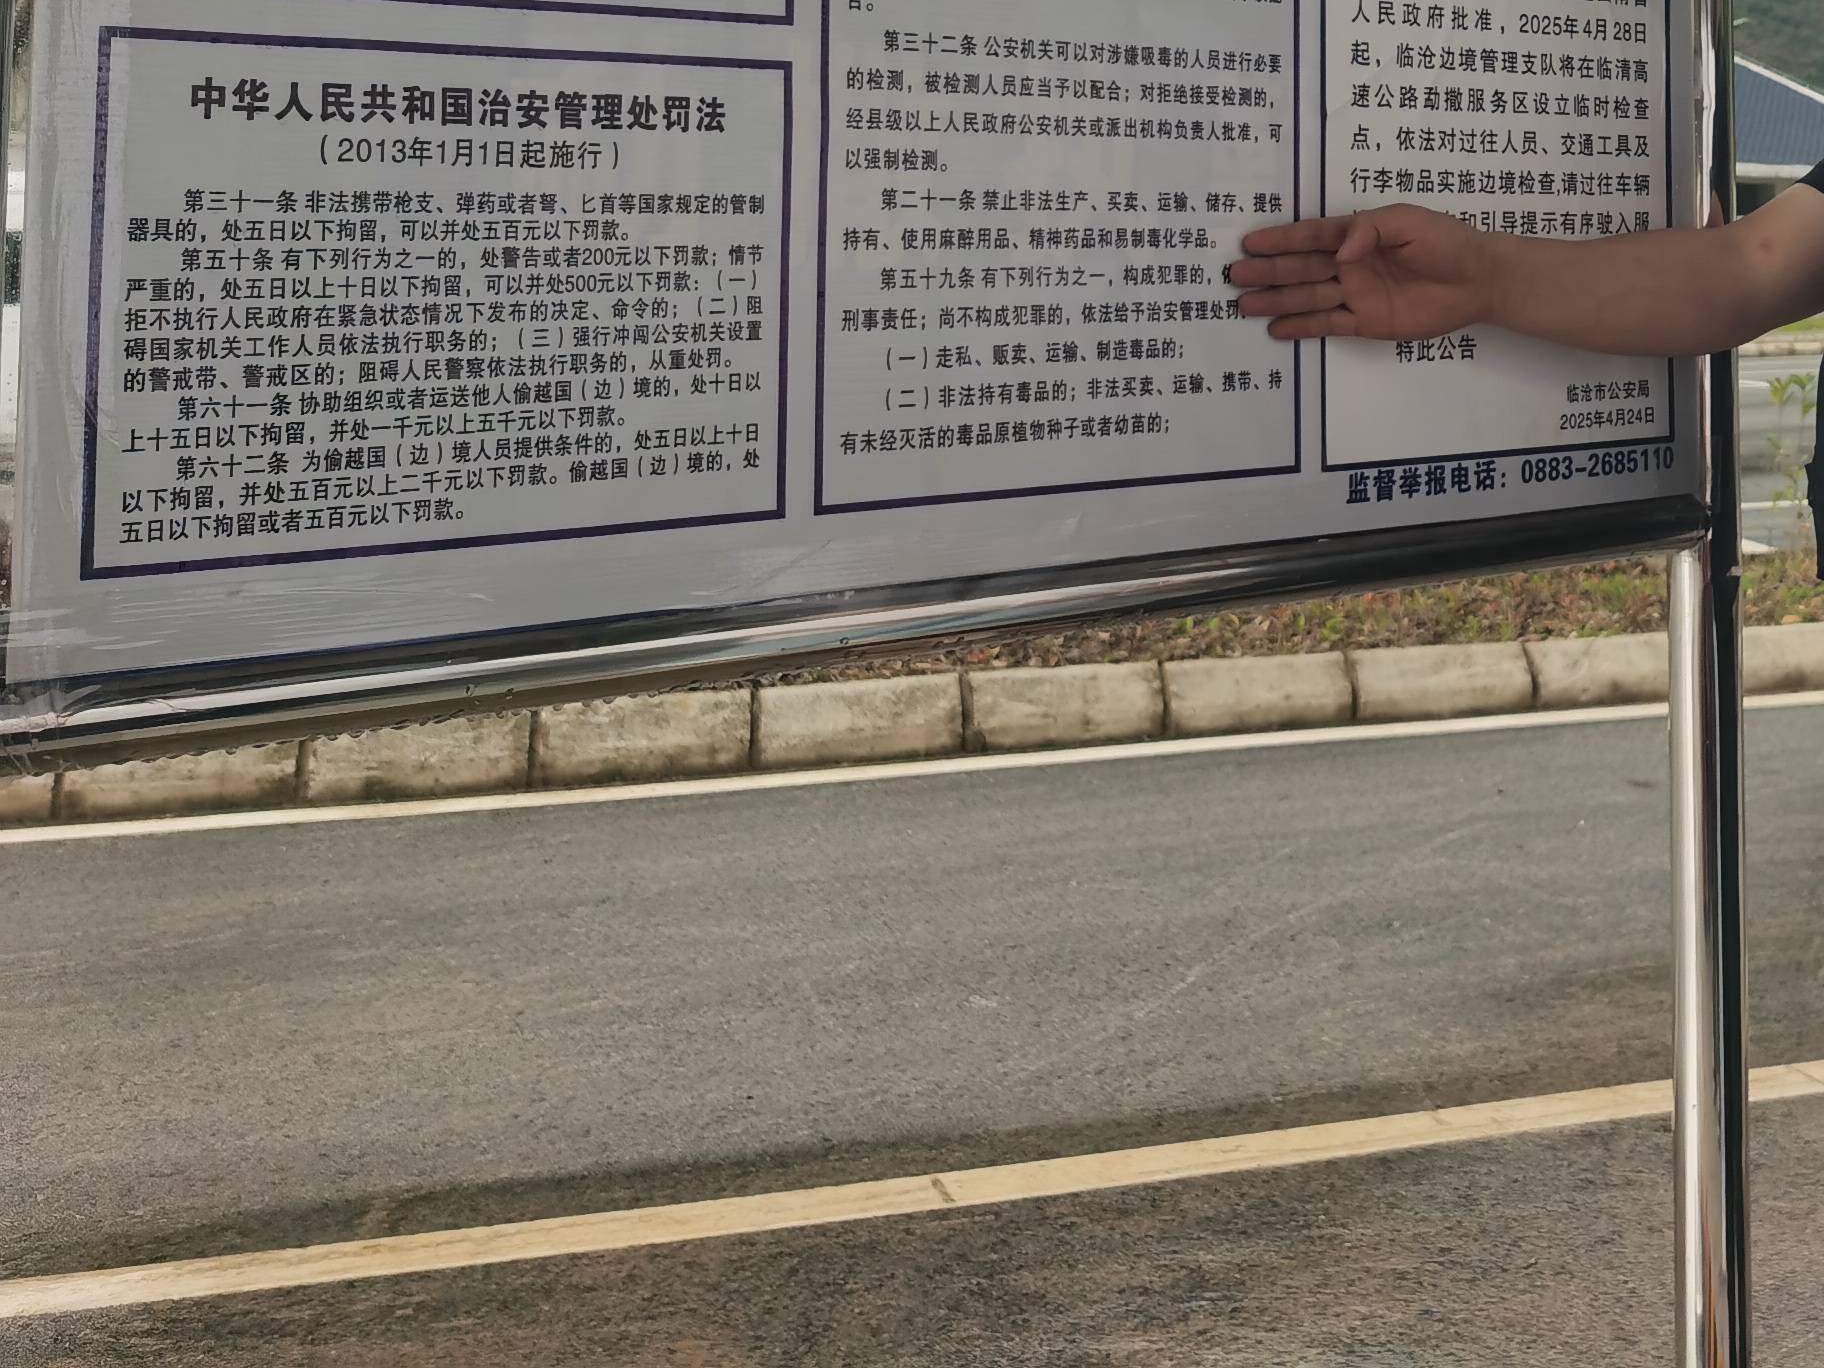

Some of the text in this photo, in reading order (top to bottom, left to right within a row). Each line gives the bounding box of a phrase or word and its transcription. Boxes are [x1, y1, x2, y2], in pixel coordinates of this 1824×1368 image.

[1350, 42, 1648, 83] 起，临沧边境管理支队将在临清高
[190, 77, 726, 133] 中华人民共和国治安管理处罚法
[1351, 84, 1649, 121] 速公路勐撒服务区设立临时检查
[319, 134, 620, 170] （2013年1月1日起施行）
[1350, 124, 1649, 158] 点，依法对过往人员、交通工具及
[845, 148, 949, 174] 以强制检测。
[1395, 334, 1477, 363] 特此公告
[1566, 379, 1650, 404] 临沧市公安局
[1560, 406, 1655, 430] 2025年4月24日
[119, 498, 464, 544] 五日以下拘留或者五百元以下罚款。
